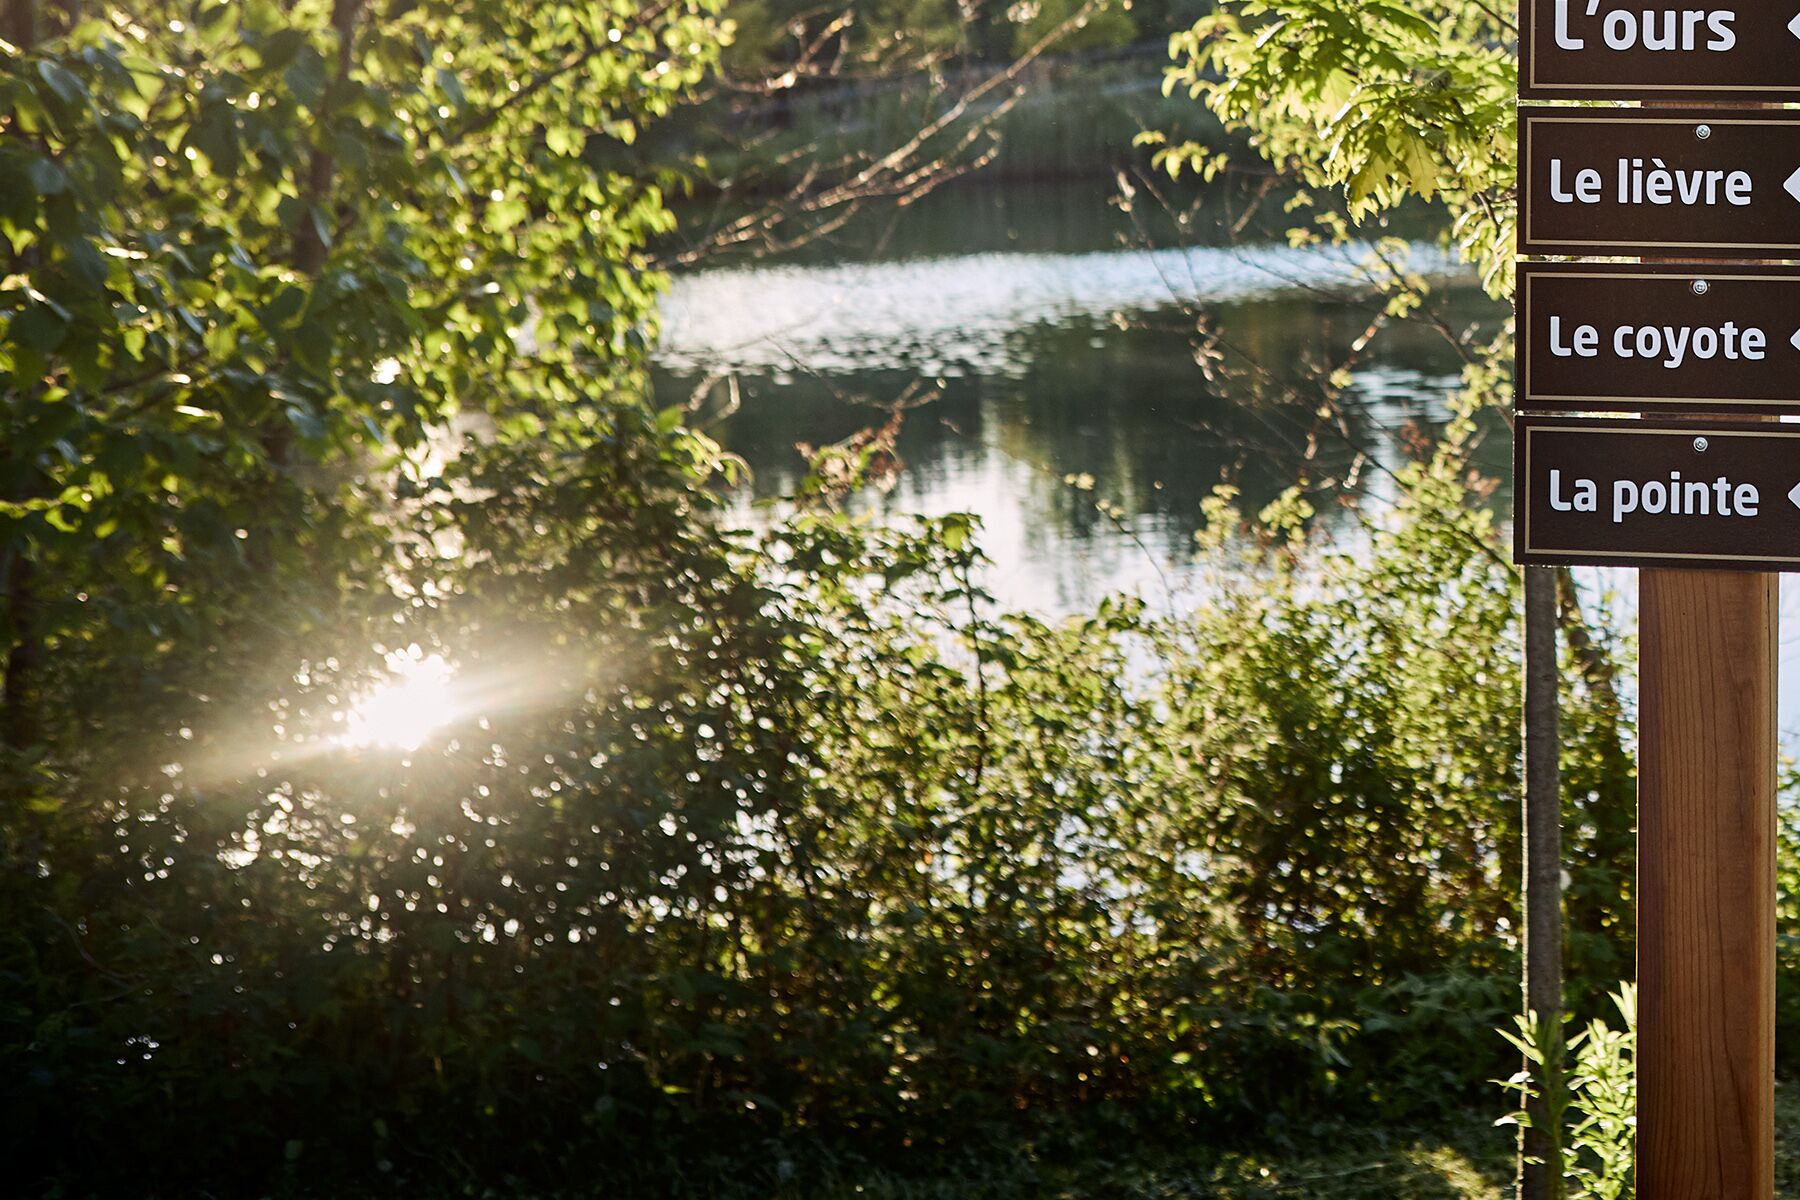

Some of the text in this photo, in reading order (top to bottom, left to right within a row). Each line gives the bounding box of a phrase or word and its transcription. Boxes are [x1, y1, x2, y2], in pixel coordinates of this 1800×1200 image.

[1550, 158, 1752, 206] Le lièvre
[1550, 315, 1766, 369] Le coyote
[1550, 469, 1759, 523] La pointe
